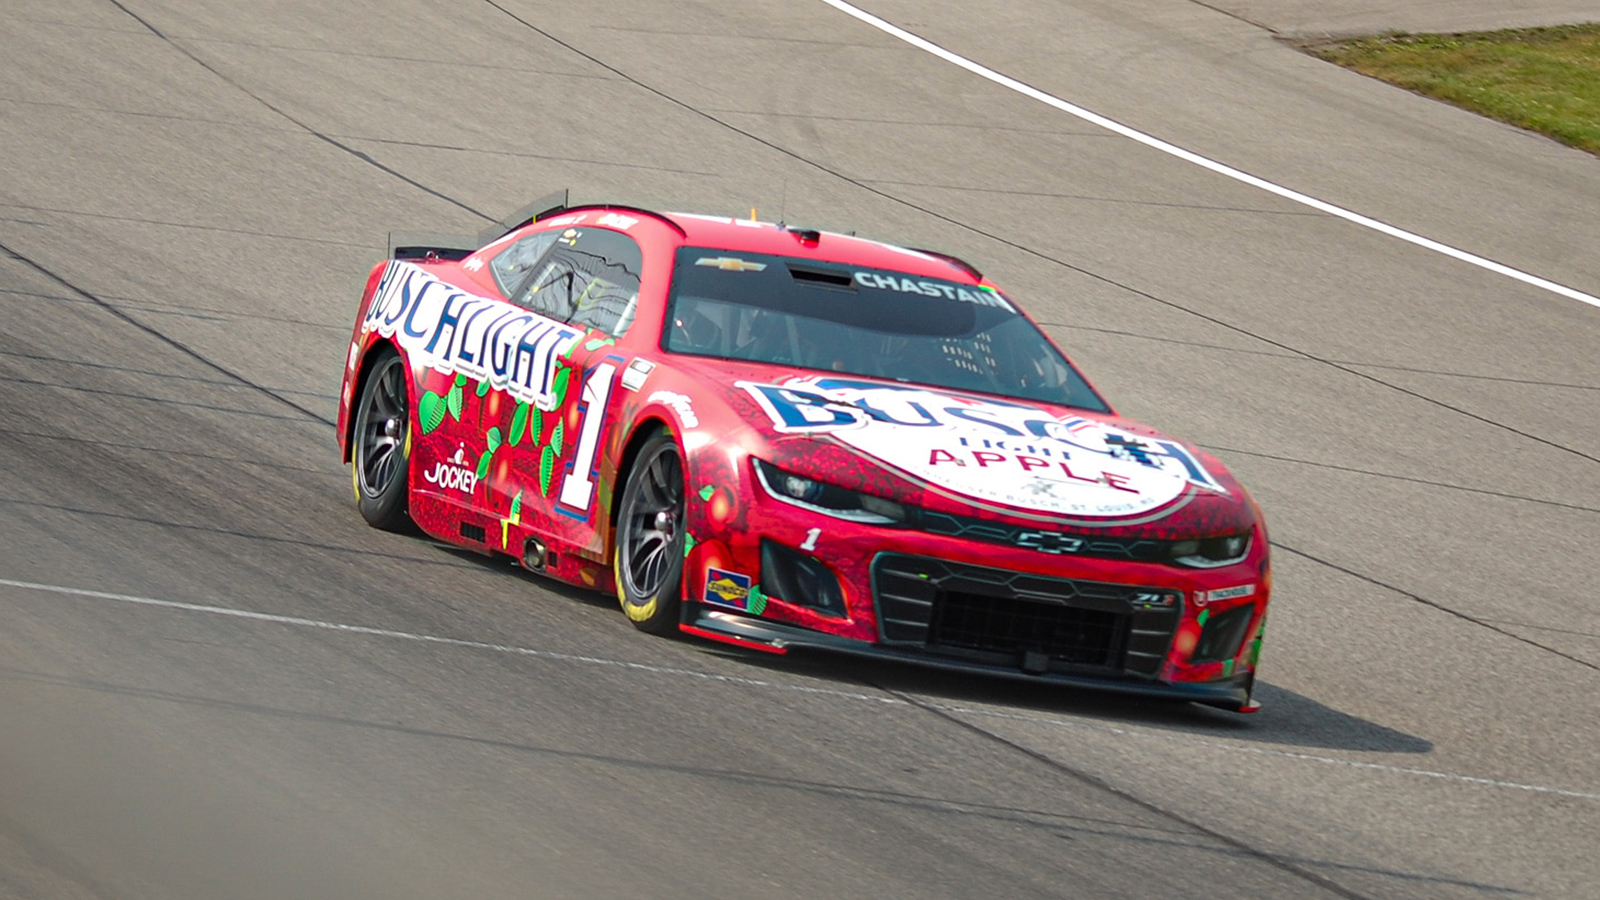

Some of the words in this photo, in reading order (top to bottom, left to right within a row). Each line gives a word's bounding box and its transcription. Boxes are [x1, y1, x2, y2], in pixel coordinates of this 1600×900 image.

[854, 271, 1018, 315] CHASTAIN
[556, 359, 622, 517] 1
[424, 462, 480, 495] JOCKEY
[928, 449, 1142, 495] APPLE
[799, 527, 822, 552] 1
